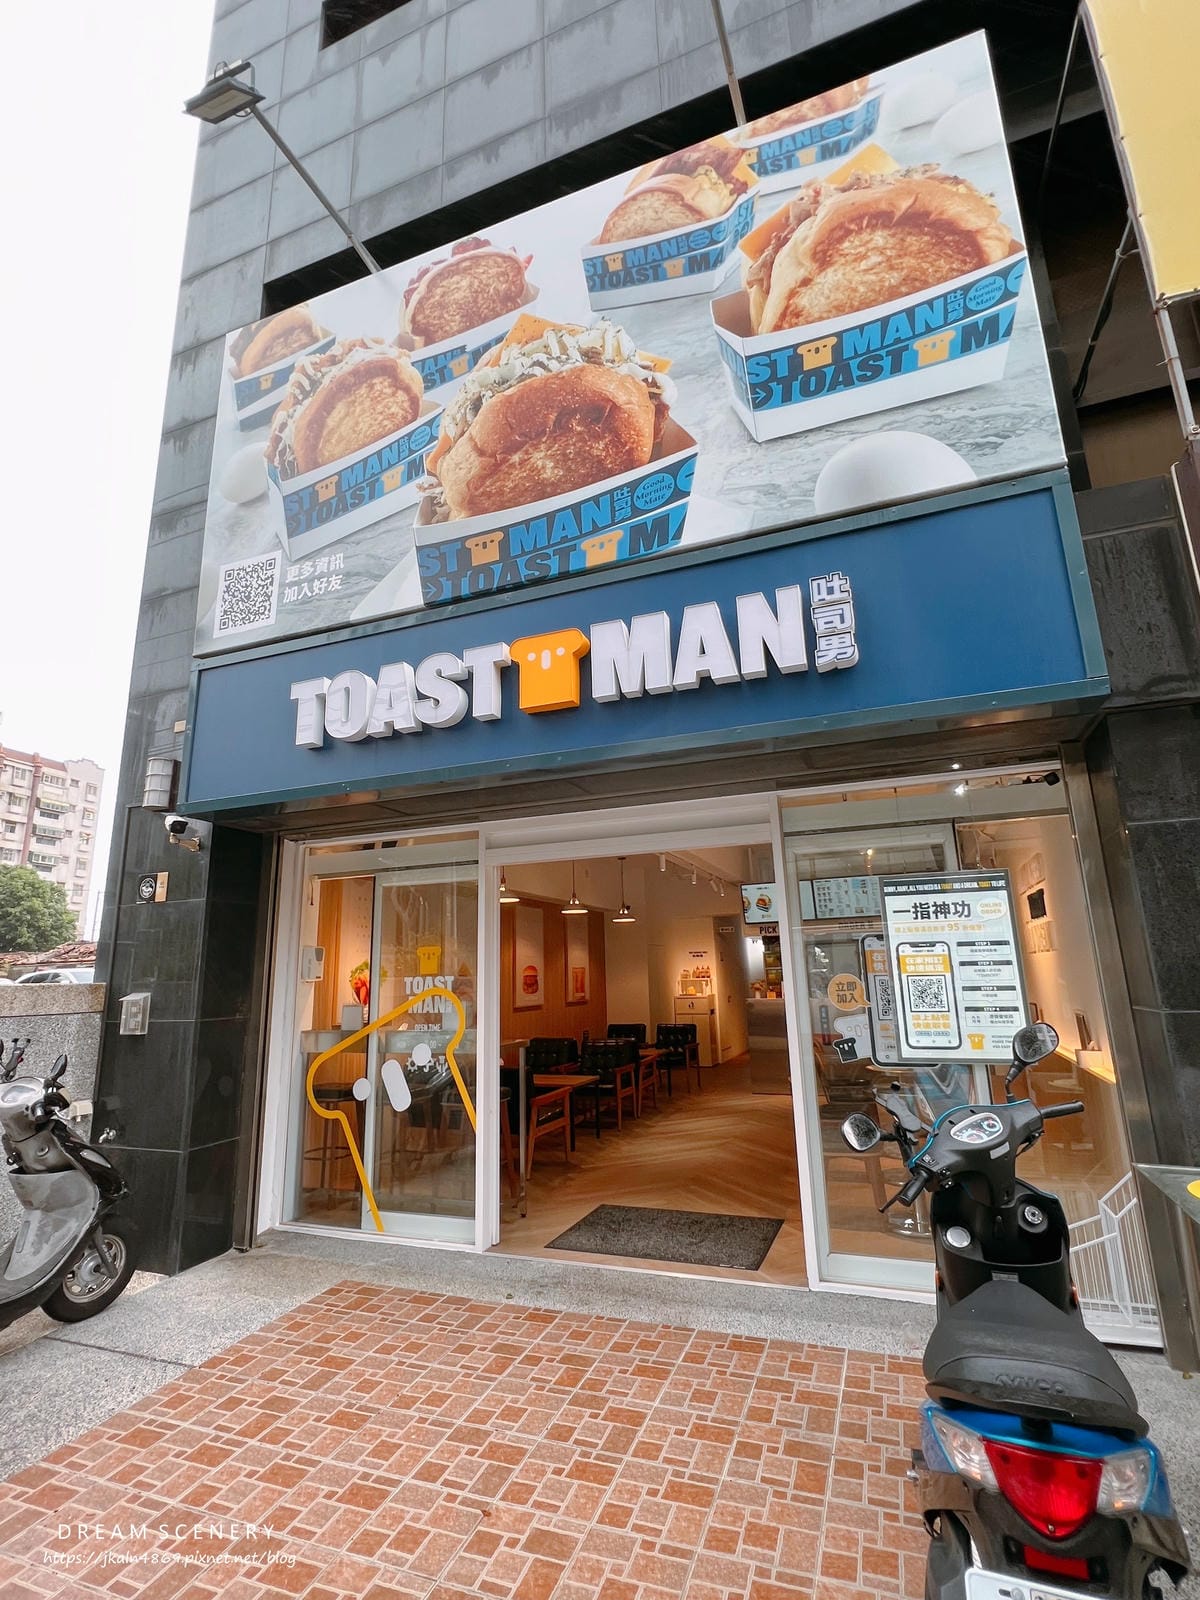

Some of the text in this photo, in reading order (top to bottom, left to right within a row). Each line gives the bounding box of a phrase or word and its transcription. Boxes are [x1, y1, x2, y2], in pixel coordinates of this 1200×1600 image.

[760, 129, 812, 160] MAN
[753, 153, 796, 177] AST
[626, 240, 679, 268] MAN
[598, 263, 662, 290] TOAST
[747, 348, 795, 385] ST
[842, 297, 946, 361] MAN
[779, 346, 911, 405] TOAST
[340, 445, 400, 492] MAN
[635, 483, 673, 501] Morning
[642, 476, 665, 491] Good
[301, 482, 382, 534] TOAST
[643, 493, 666, 507] Mate
[419, 494, 613, 577] ST MAN
[285, 552, 345, 583] 更多資訊
[445, 547, 578, 602] TOAST
[282, 574, 344, 604] 加入好友
[809, 571, 859, 673] 吐司男
[291, 585, 808, 749] TOAST MAN
[892, 900, 971, 920] 一指神功
[759, 926, 777, 934] PICK
[946, 923, 960, 931] 95
[404, 976, 454, 995] TOAST
[835, 981, 857, 992] 立即
[836, 993, 859, 1004] 加入
